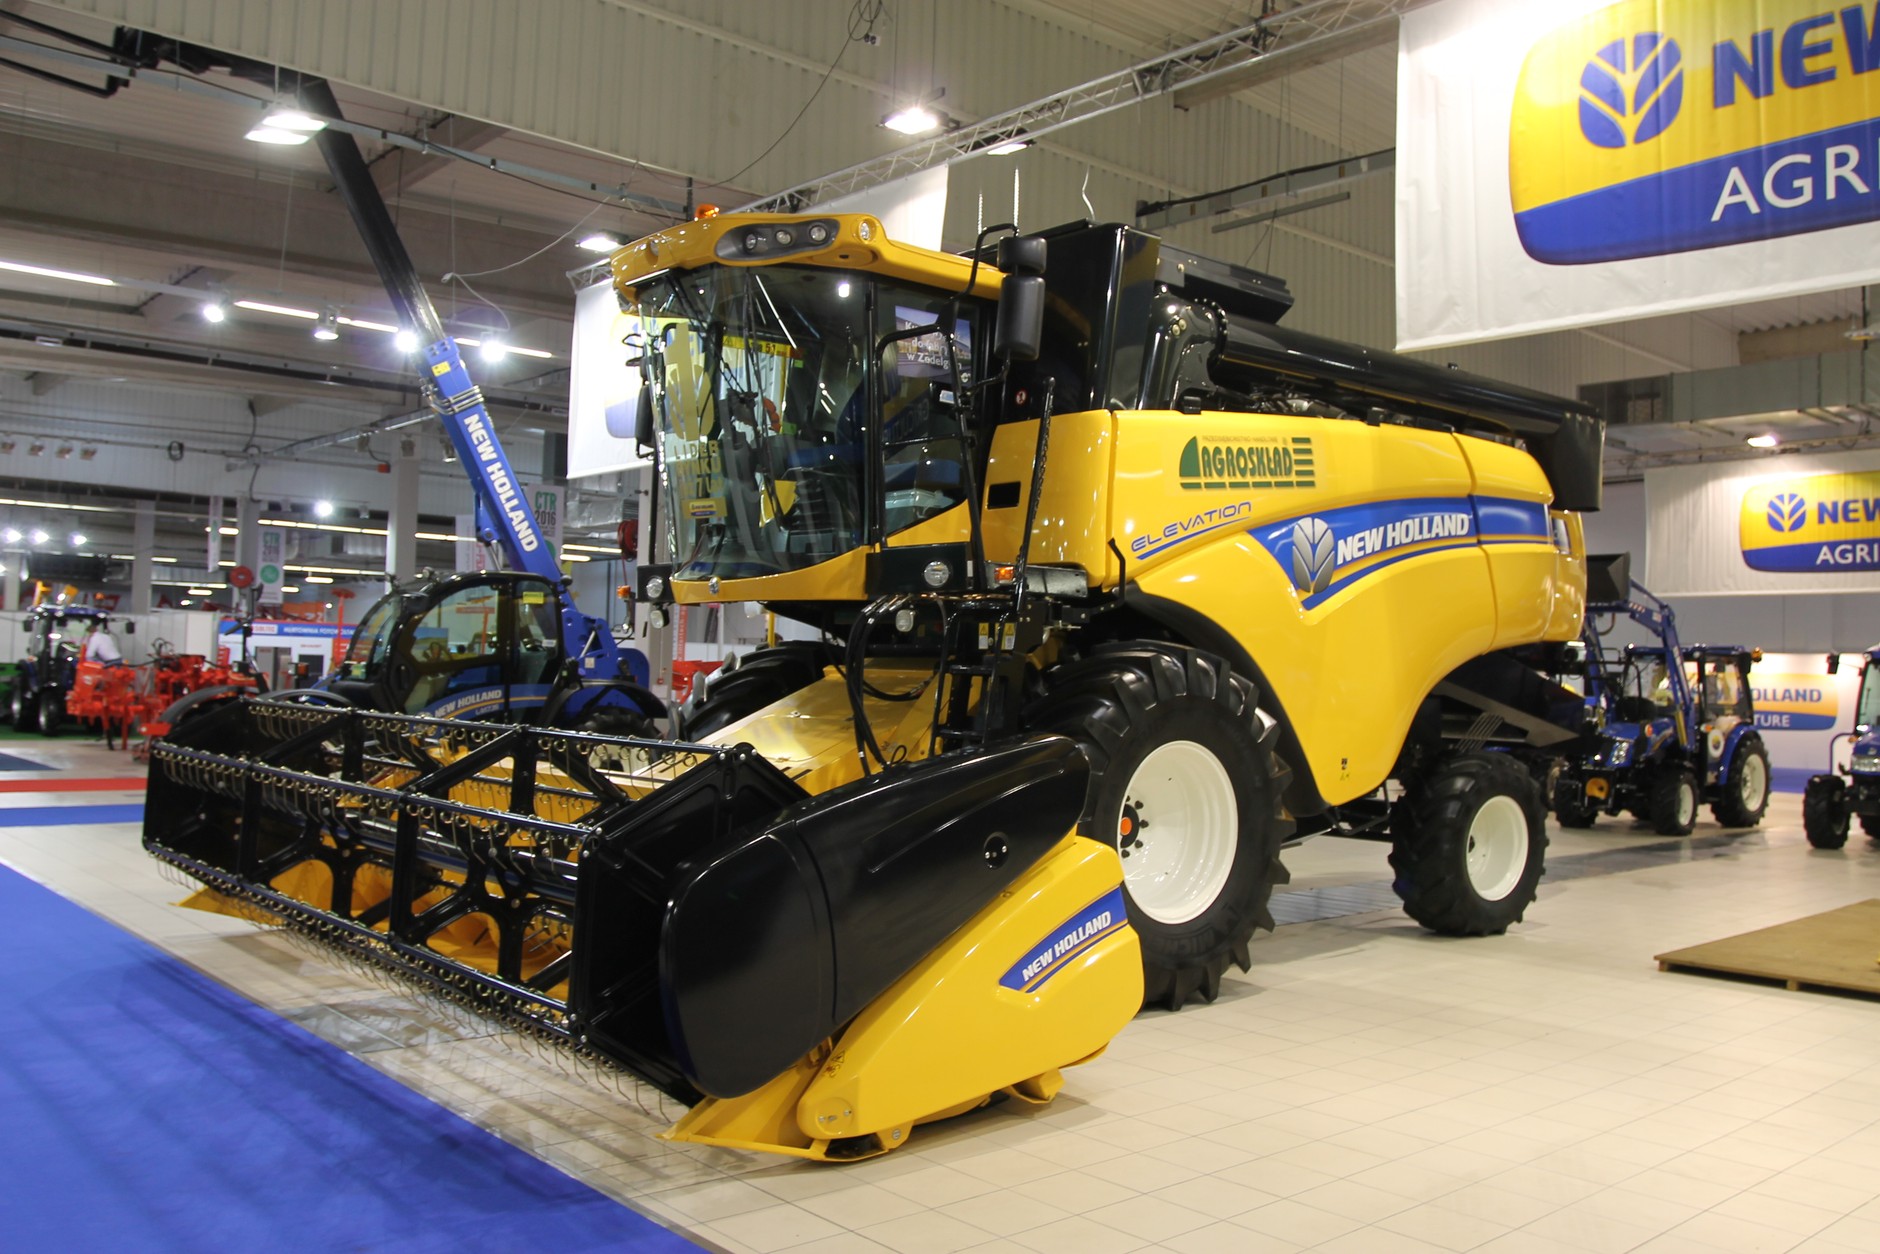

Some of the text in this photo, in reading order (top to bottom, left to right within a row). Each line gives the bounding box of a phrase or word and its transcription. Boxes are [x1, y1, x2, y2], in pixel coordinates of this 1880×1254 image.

[1710, 137, 1880, 222] AGR
[674, 440, 720, 460] LIDER
[1201, 445, 1293, 478] AGROSKŁAD
[463, 413, 498, 462] NEW
[486, 461, 539, 552] HOLLAND
[534, 491, 557, 511] CTR
[1817, 498, 1880, 525] NEW
[534, 510, 557, 526] 2016
[1131, 501, 1252, 552] ELEVATION
[1337, 513, 1470, 566] NEW HOLLAND
[1815, 543, 1880, 565] AGRI
[434, 689, 502, 718] NEW HOLLAND
[1750, 687, 1822, 703] OLLAND
[1022, 911, 1112, 982] NEW HOLLAND
